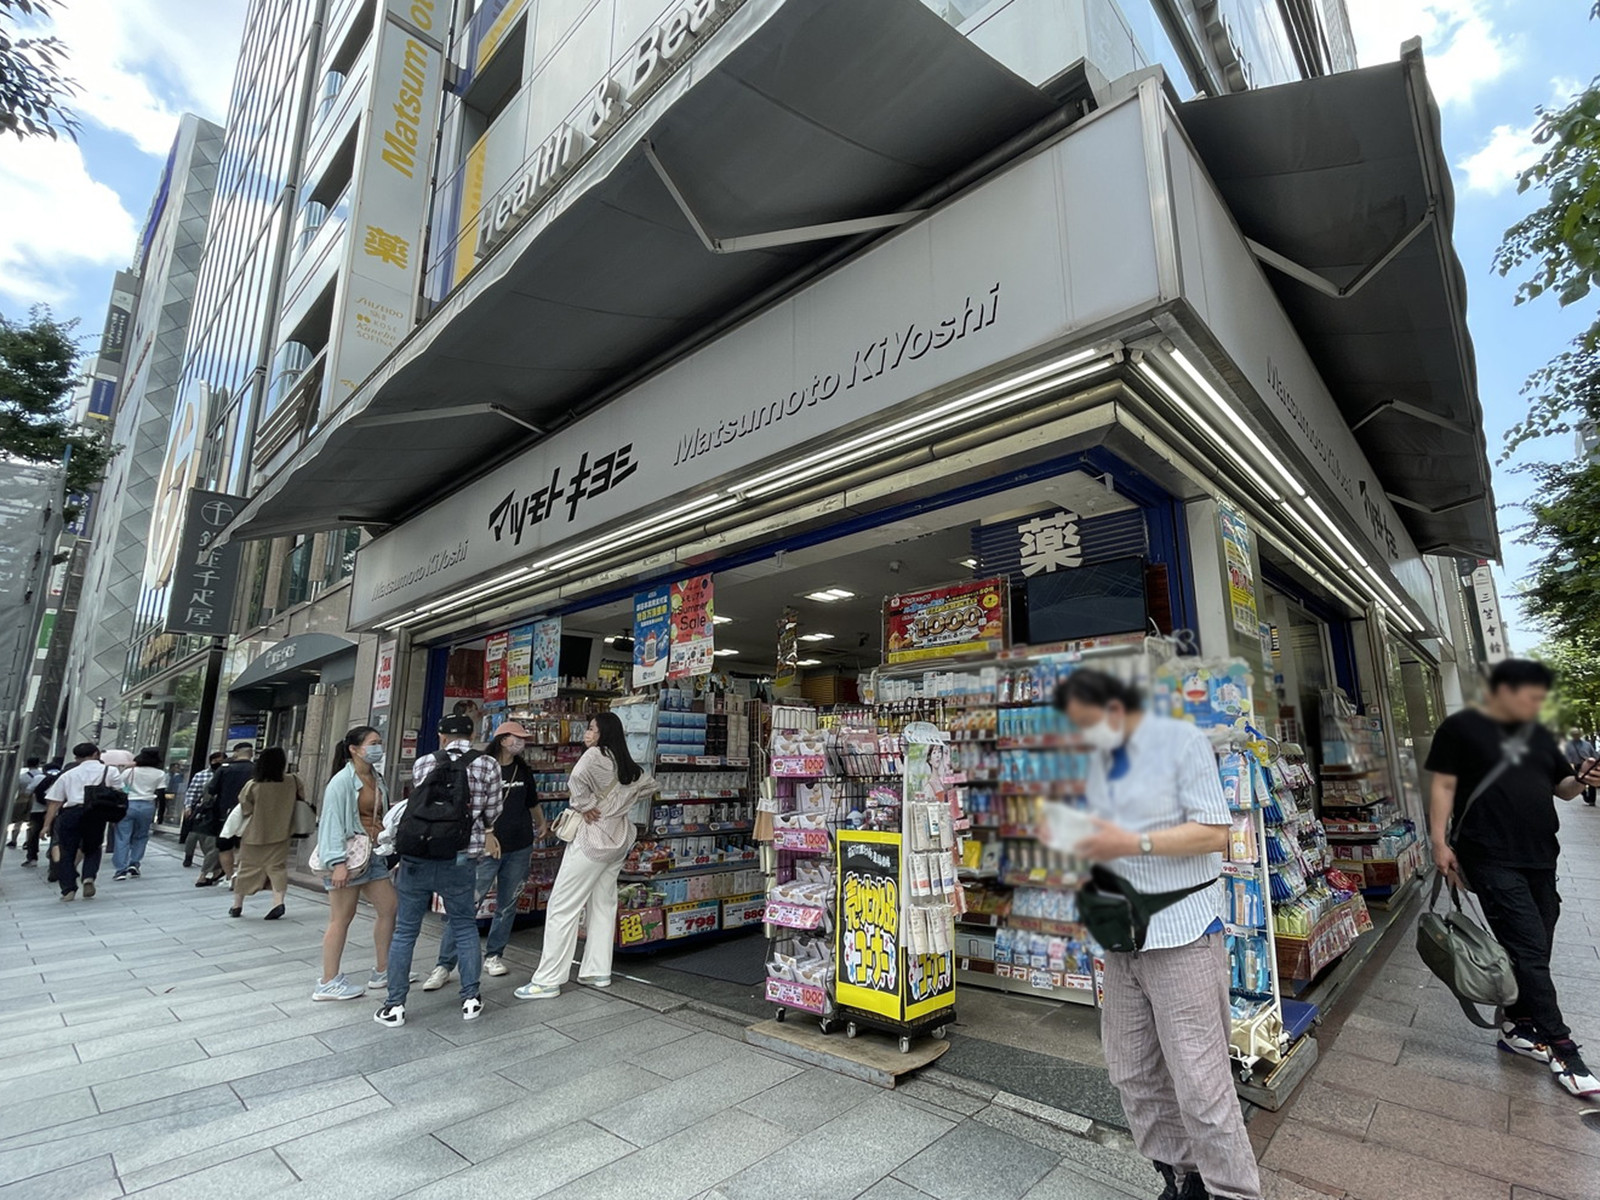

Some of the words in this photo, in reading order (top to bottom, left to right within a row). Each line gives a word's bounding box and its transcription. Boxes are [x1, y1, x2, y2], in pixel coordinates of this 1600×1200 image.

[473, 121, 583, 258] Health
[586, 75, 626, 140] &
[626, 0, 720, 100] Bea
[363, 224, 410, 270] 薬
[356, 297, 404, 319] SHISEIDO
[673, 373, 840, 466] Matsumoto
[846, 281, 1001, 390] KiYoshi
[488, 442, 639, 546] マツモトキヨシ
[1018, 511, 1083, 577] 薬
[371, 564, 427, 602] Matsumoto
[680, 615, 706, 632] Sale
[620, 912, 644, 945] 超
